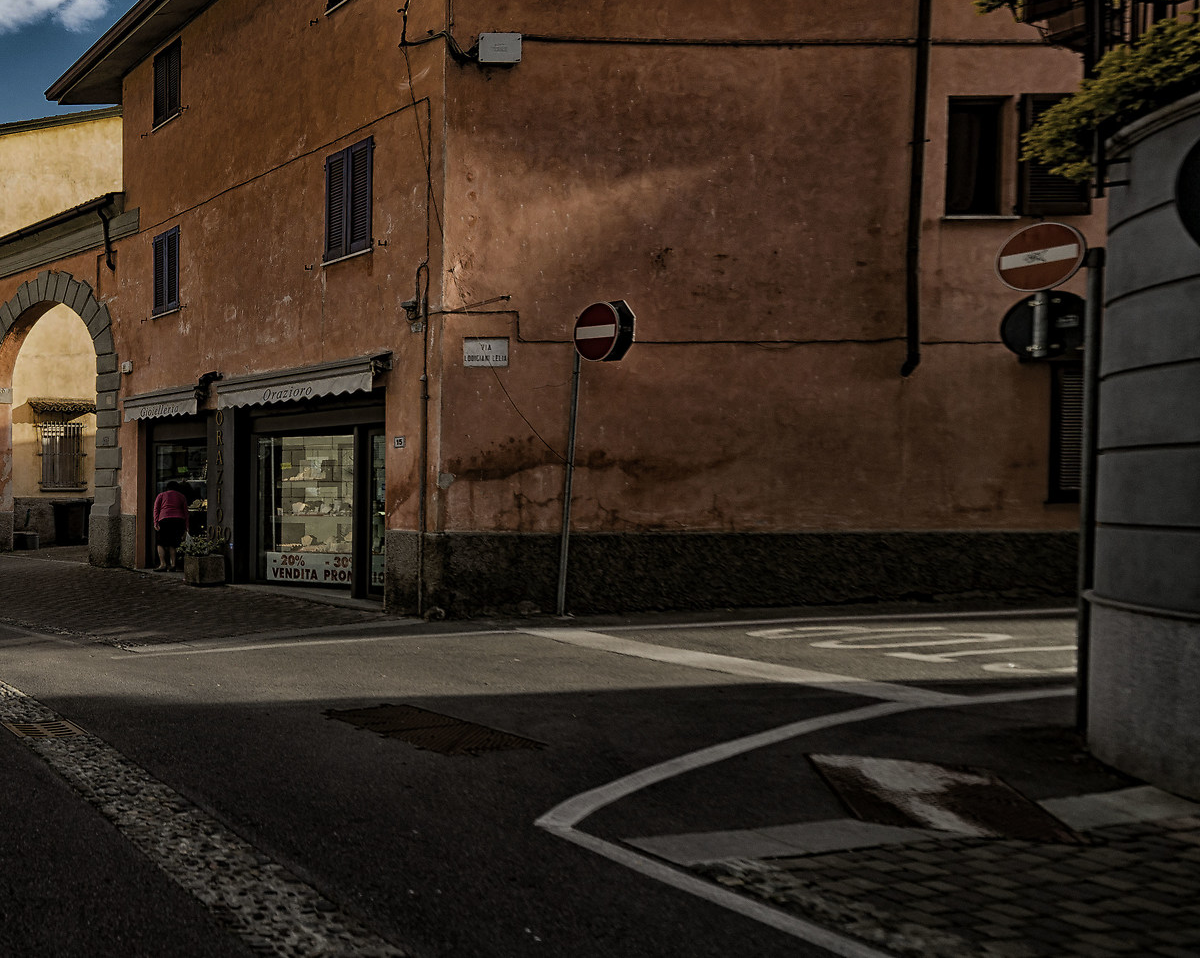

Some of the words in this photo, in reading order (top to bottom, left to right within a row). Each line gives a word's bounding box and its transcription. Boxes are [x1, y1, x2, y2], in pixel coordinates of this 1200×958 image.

[262, 385, 313, 402] Orazioro
[140, 404, 179, 418] Gioielleria
[280, 554, 306, 568] 20%
[272, 567, 319, 581] VENDITA
